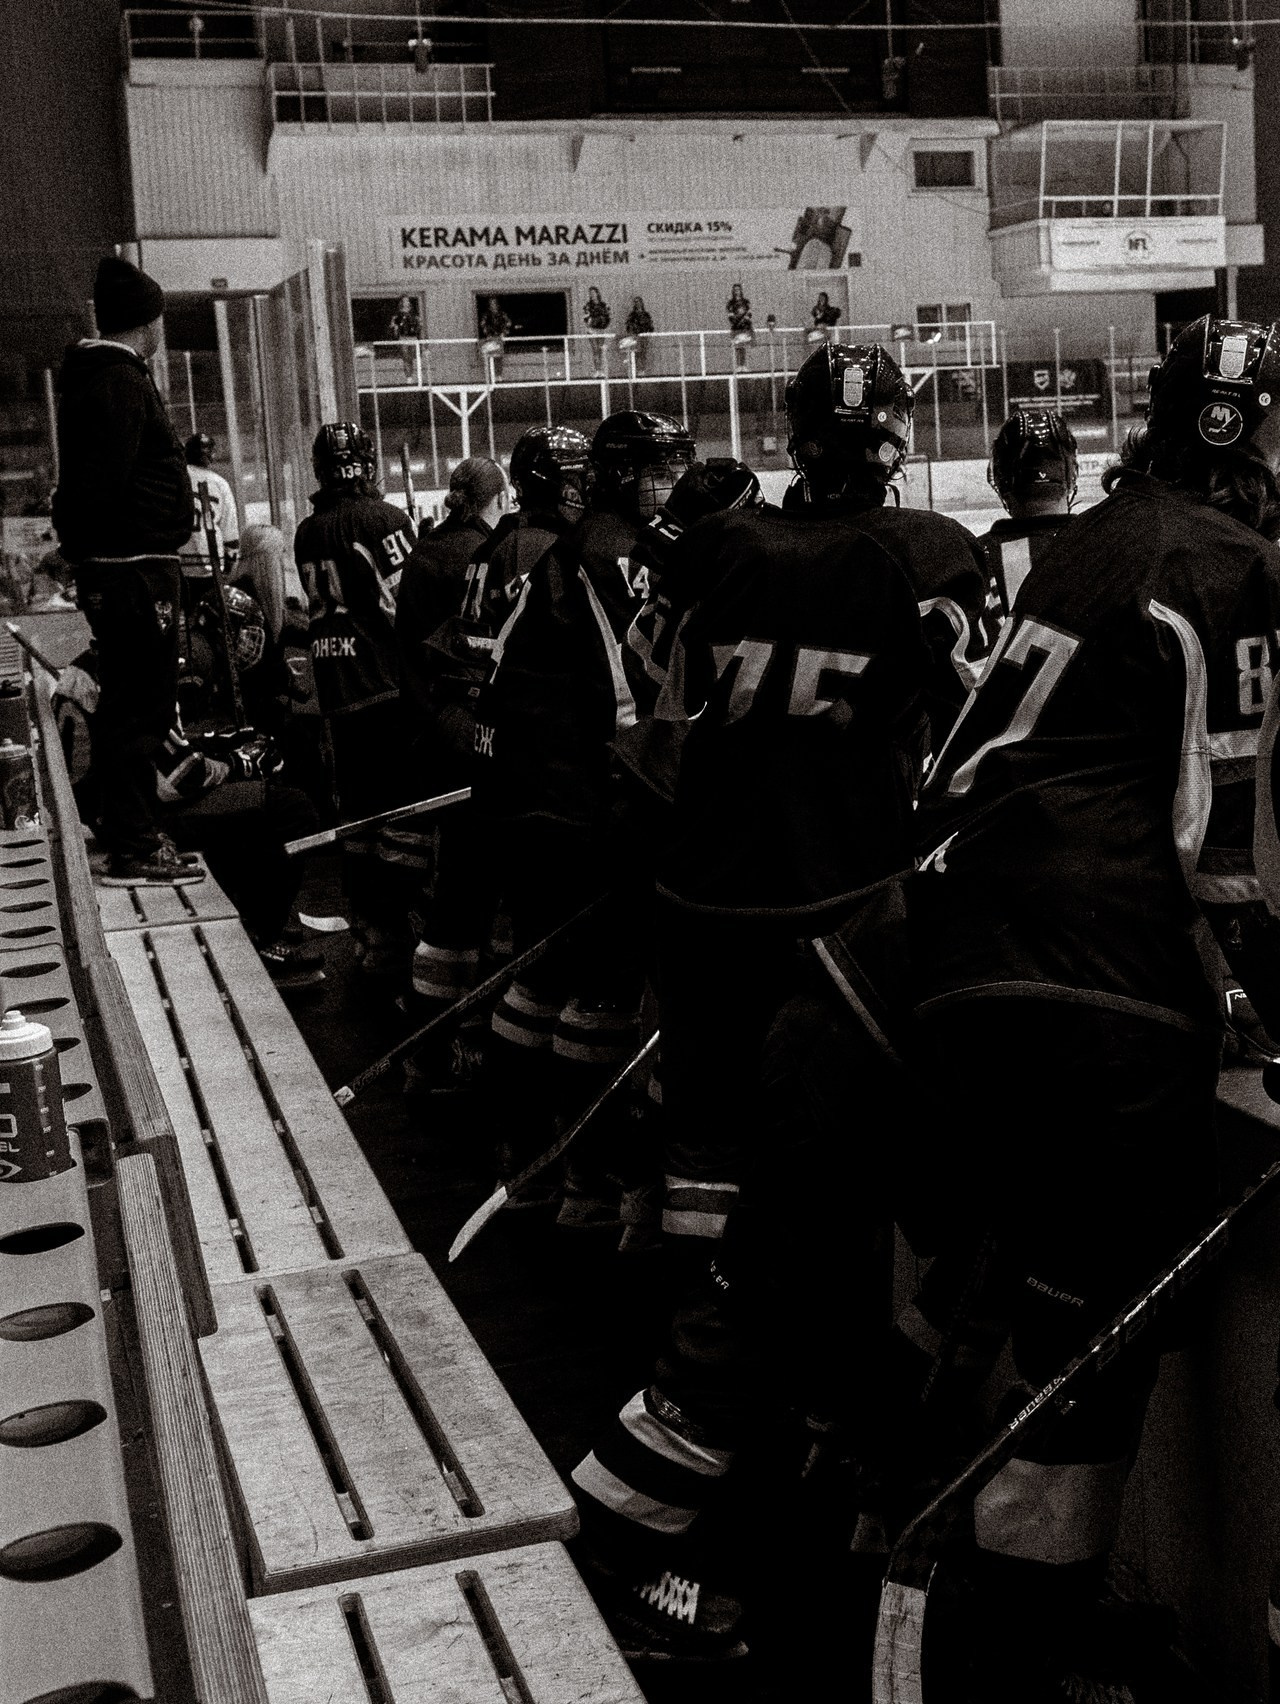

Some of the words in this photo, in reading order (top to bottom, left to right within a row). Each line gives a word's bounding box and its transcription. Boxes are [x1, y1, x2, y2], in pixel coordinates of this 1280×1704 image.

[401, 226, 509, 248] KERAMA
[515, 223, 629, 245] MARAZZI
[646, 222, 702, 235] СКИДКА
[707, 221, 733, 233] 15%
[403, 253, 488, 269] КРАСОТА
[493, 253, 542, 270] ДЕНЬ
[549, 251, 570, 266] ЗА
[575, 248, 629, 267] ДНЁМ
[381, 528, 413, 567] 91
